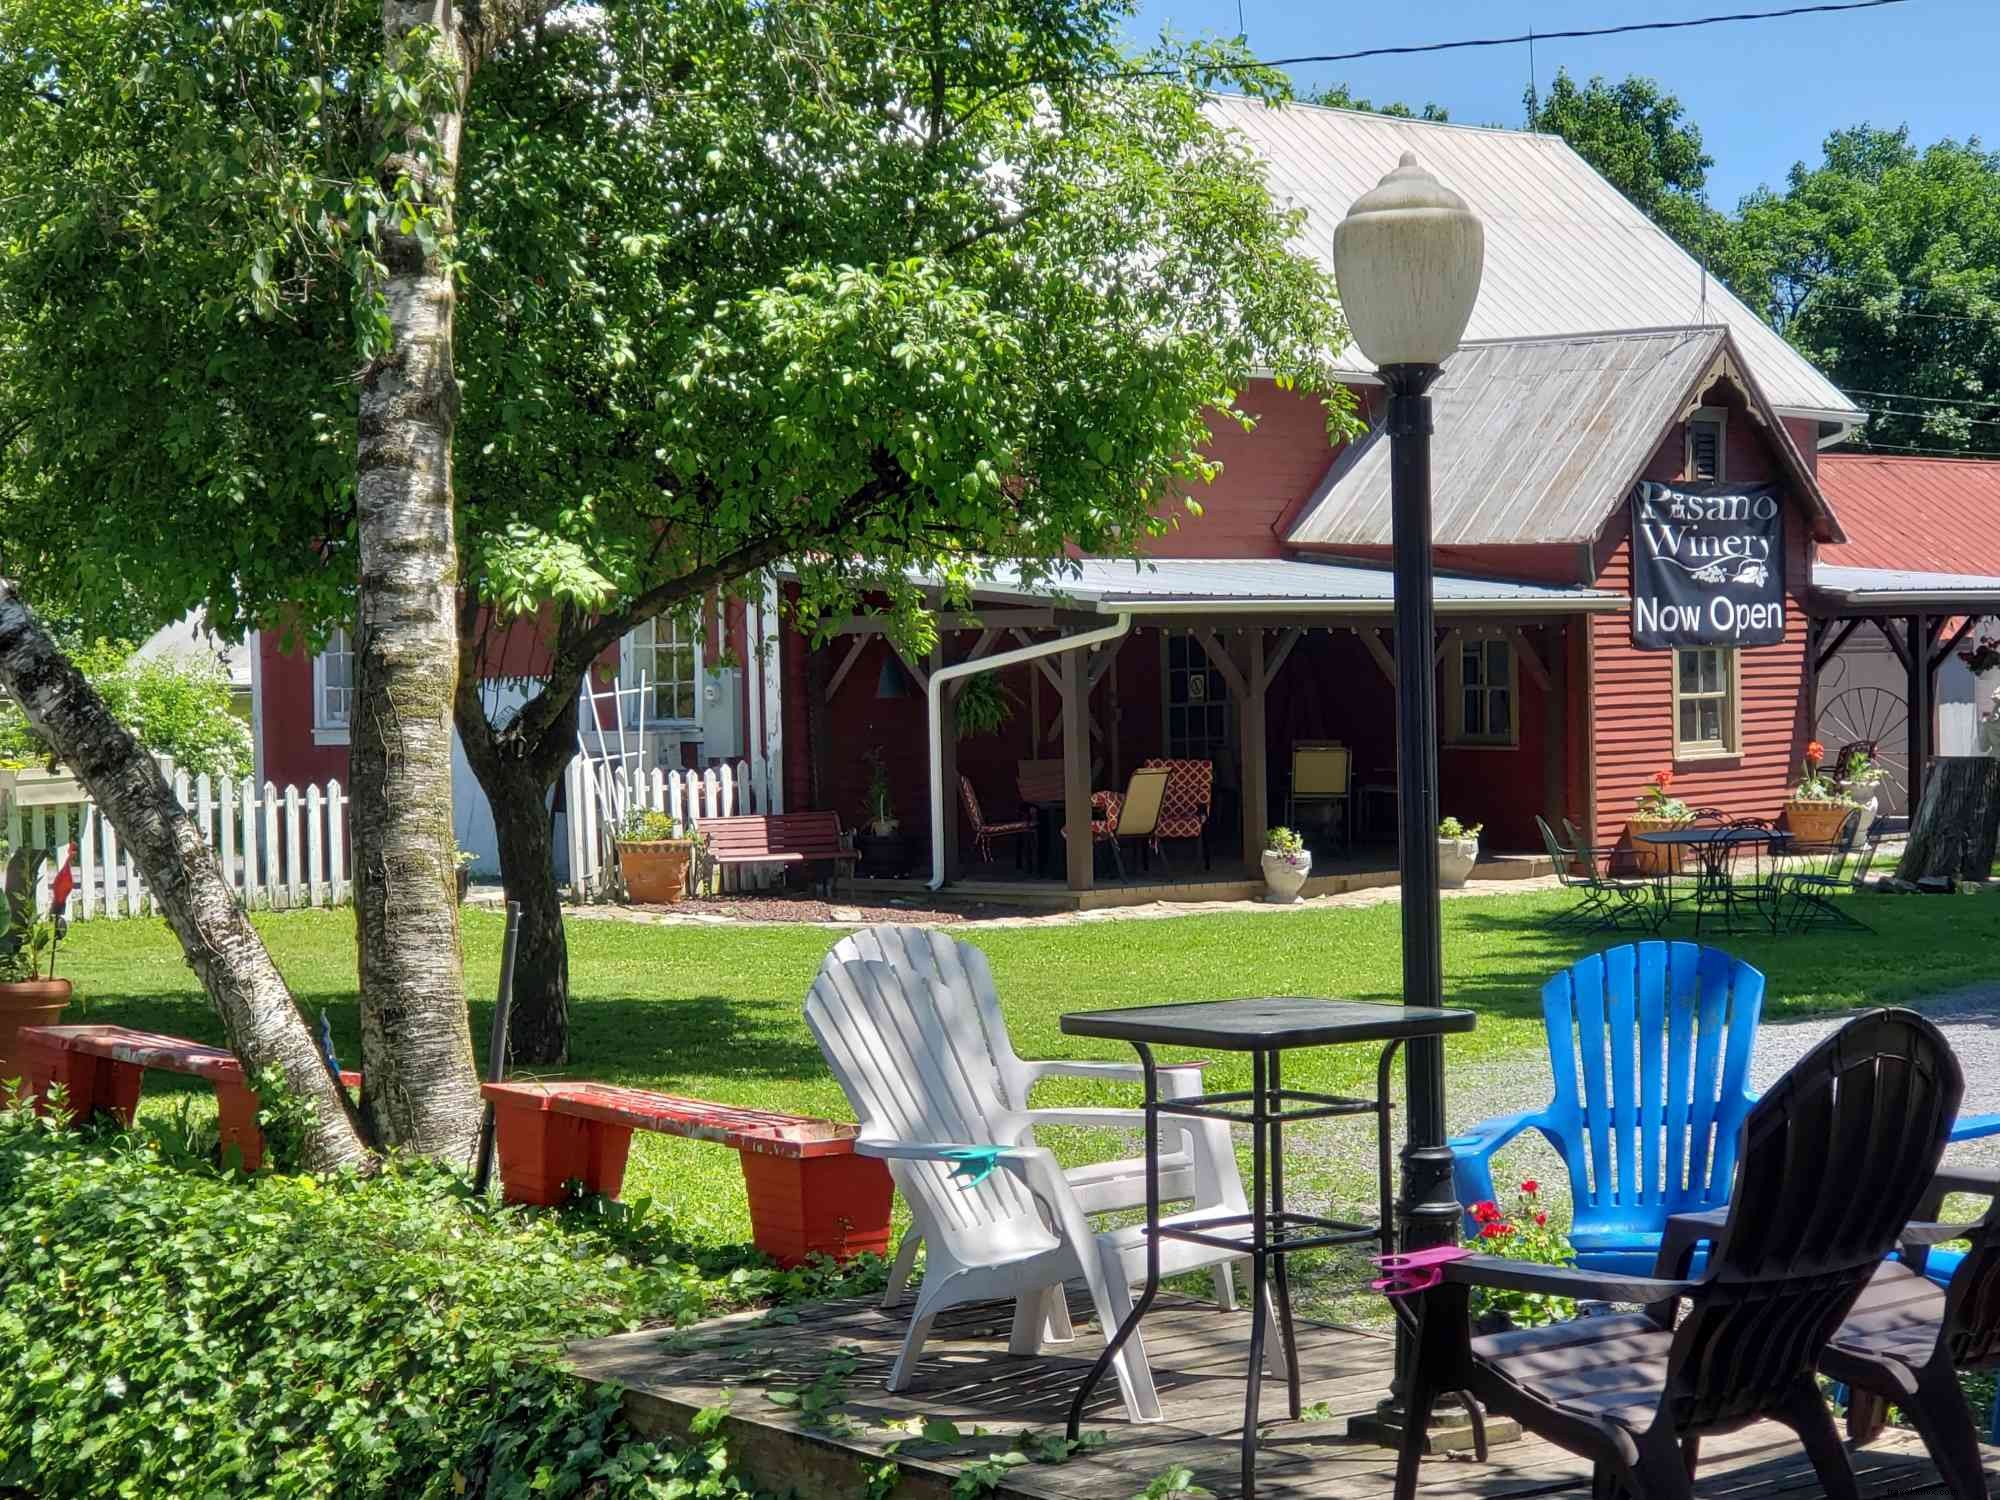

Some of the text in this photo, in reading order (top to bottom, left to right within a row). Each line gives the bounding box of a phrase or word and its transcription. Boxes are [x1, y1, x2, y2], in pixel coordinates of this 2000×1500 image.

[1641, 480, 1778, 520] Pisano
[1640, 523, 1775, 561] Winery
[1637, 595, 1783, 639] Now Open
